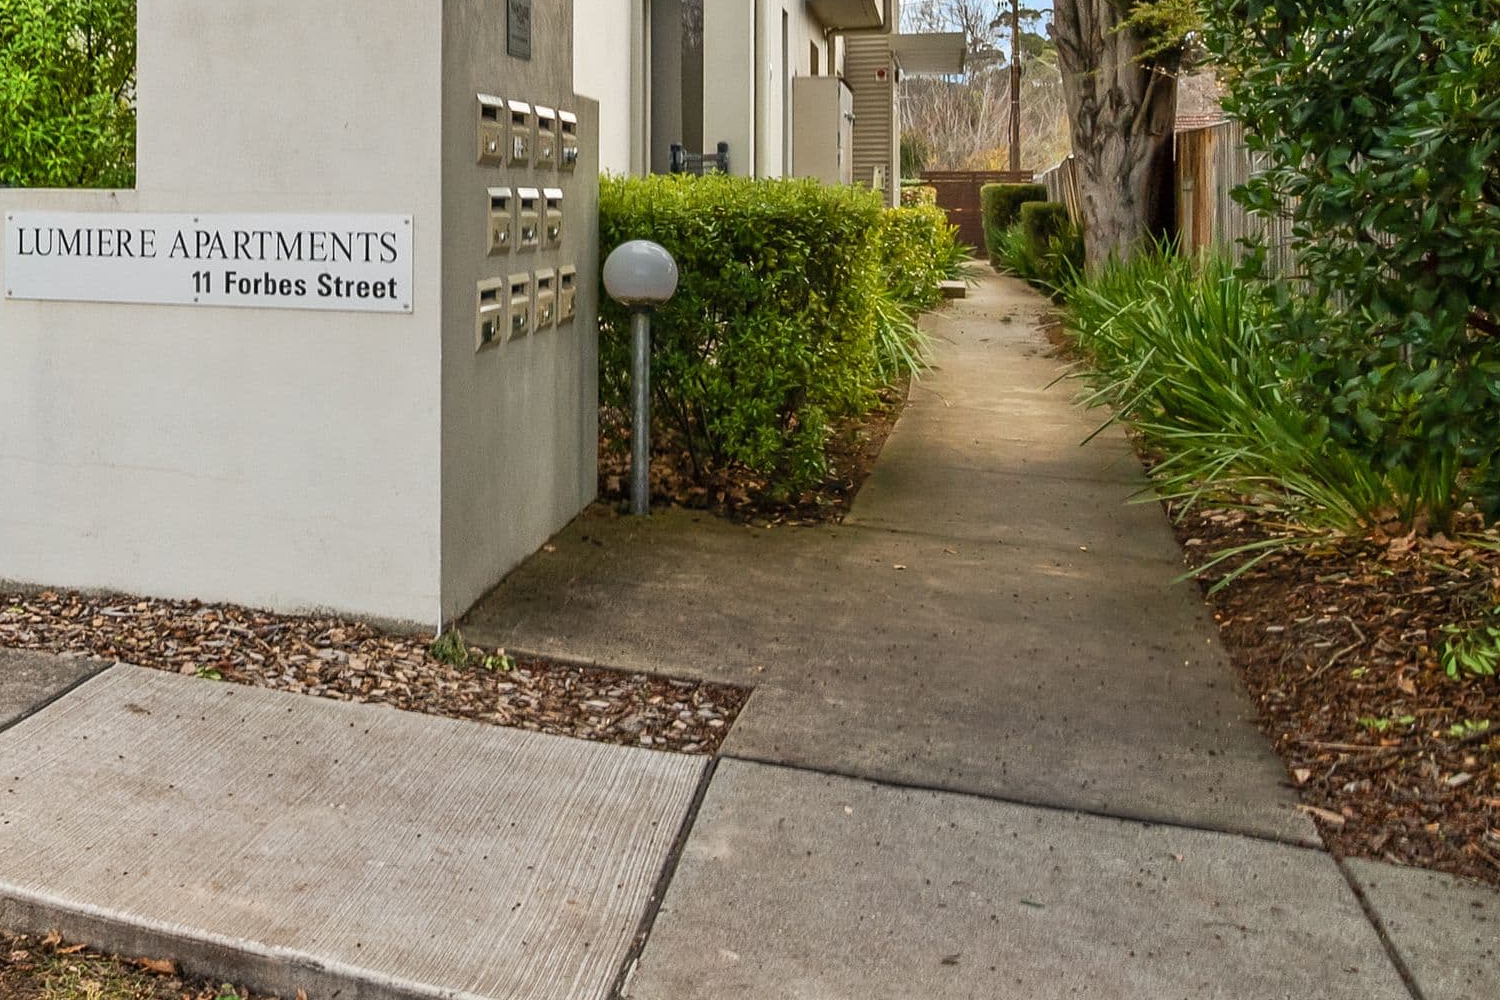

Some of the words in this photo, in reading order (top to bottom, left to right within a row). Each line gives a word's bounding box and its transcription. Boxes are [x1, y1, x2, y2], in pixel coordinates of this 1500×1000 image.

[18, 228, 157, 258] LUMIERE
[169, 230, 398, 263] APARTMENTS
[192, 271, 212, 294] 11
[225, 271, 307, 297] Forbes
[317, 273, 398, 299] Street
